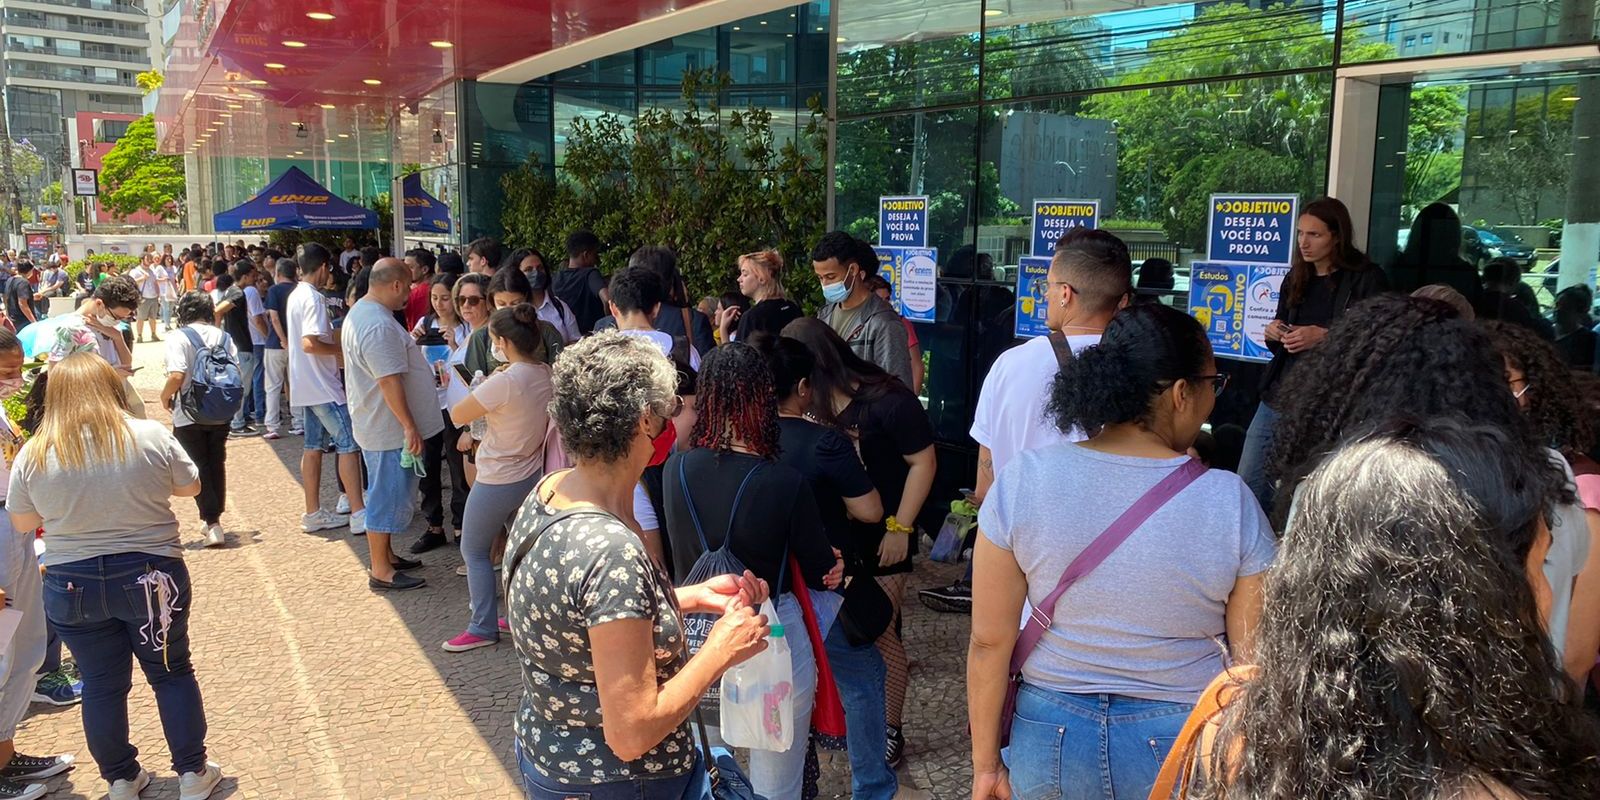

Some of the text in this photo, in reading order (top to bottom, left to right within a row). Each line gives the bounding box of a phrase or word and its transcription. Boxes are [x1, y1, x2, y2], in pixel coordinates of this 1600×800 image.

[270, 194, 329, 203] UNIP
[892, 201, 924, 210] OBJETIVO
[1232, 201, 1290, 214] OBJETIVO
[1050, 205, 1094, 217] OBJETIVO
[241, 217, 276, 226] UNIP
[888, 212, 919, 221] DESEJA A
[886, 221, 920, 231] VOCÊ BOA
[1043, 218, 1075, 228] DESEJA
[1224, 217, 1278, 227] DESEJA A
[891, 233, 914, 241] PROVA
[1220, 227, 1281, 241] VOCÊ BOA
[1229, 243, 1270, 255] PROVA
[1025, 265, 1047, 274] Estudos
[1199, 270, 1229, 281] Estudos
[1232, 273, 1246, 331] OBJETIVO
[1249, 305, 1269, 313] Confira
